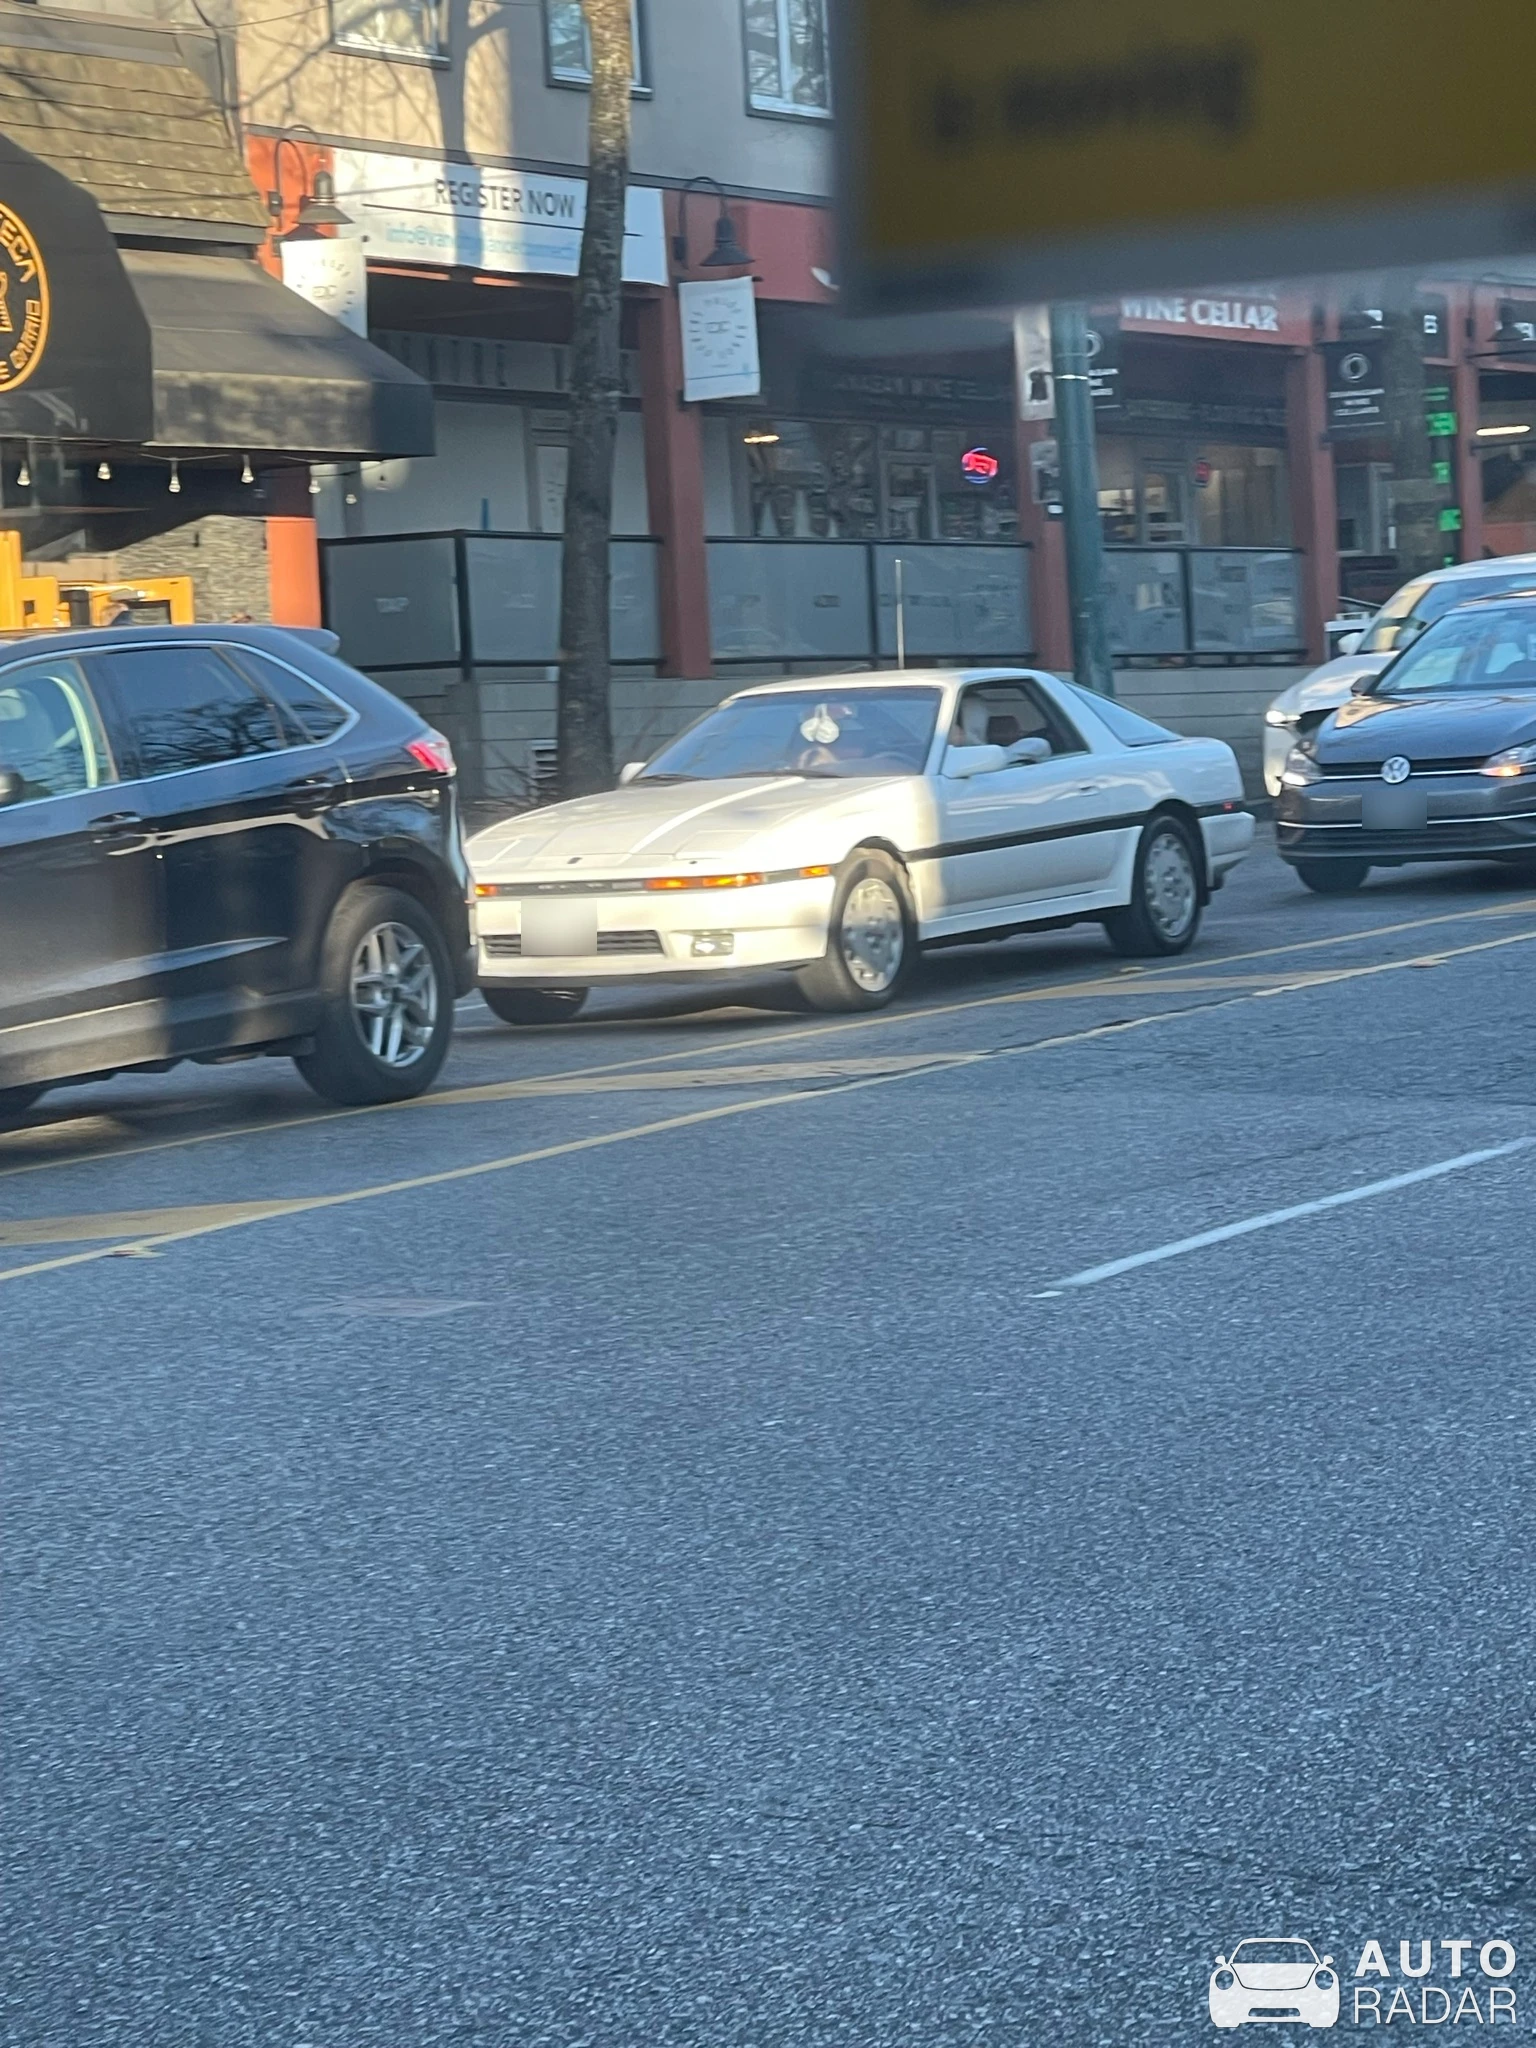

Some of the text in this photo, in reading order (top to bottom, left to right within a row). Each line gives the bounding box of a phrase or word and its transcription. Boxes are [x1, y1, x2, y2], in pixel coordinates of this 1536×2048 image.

[435, 178, 575, 218] REGISTER NOW
[1120, 297, 1280, 331] WINE CELLAR
